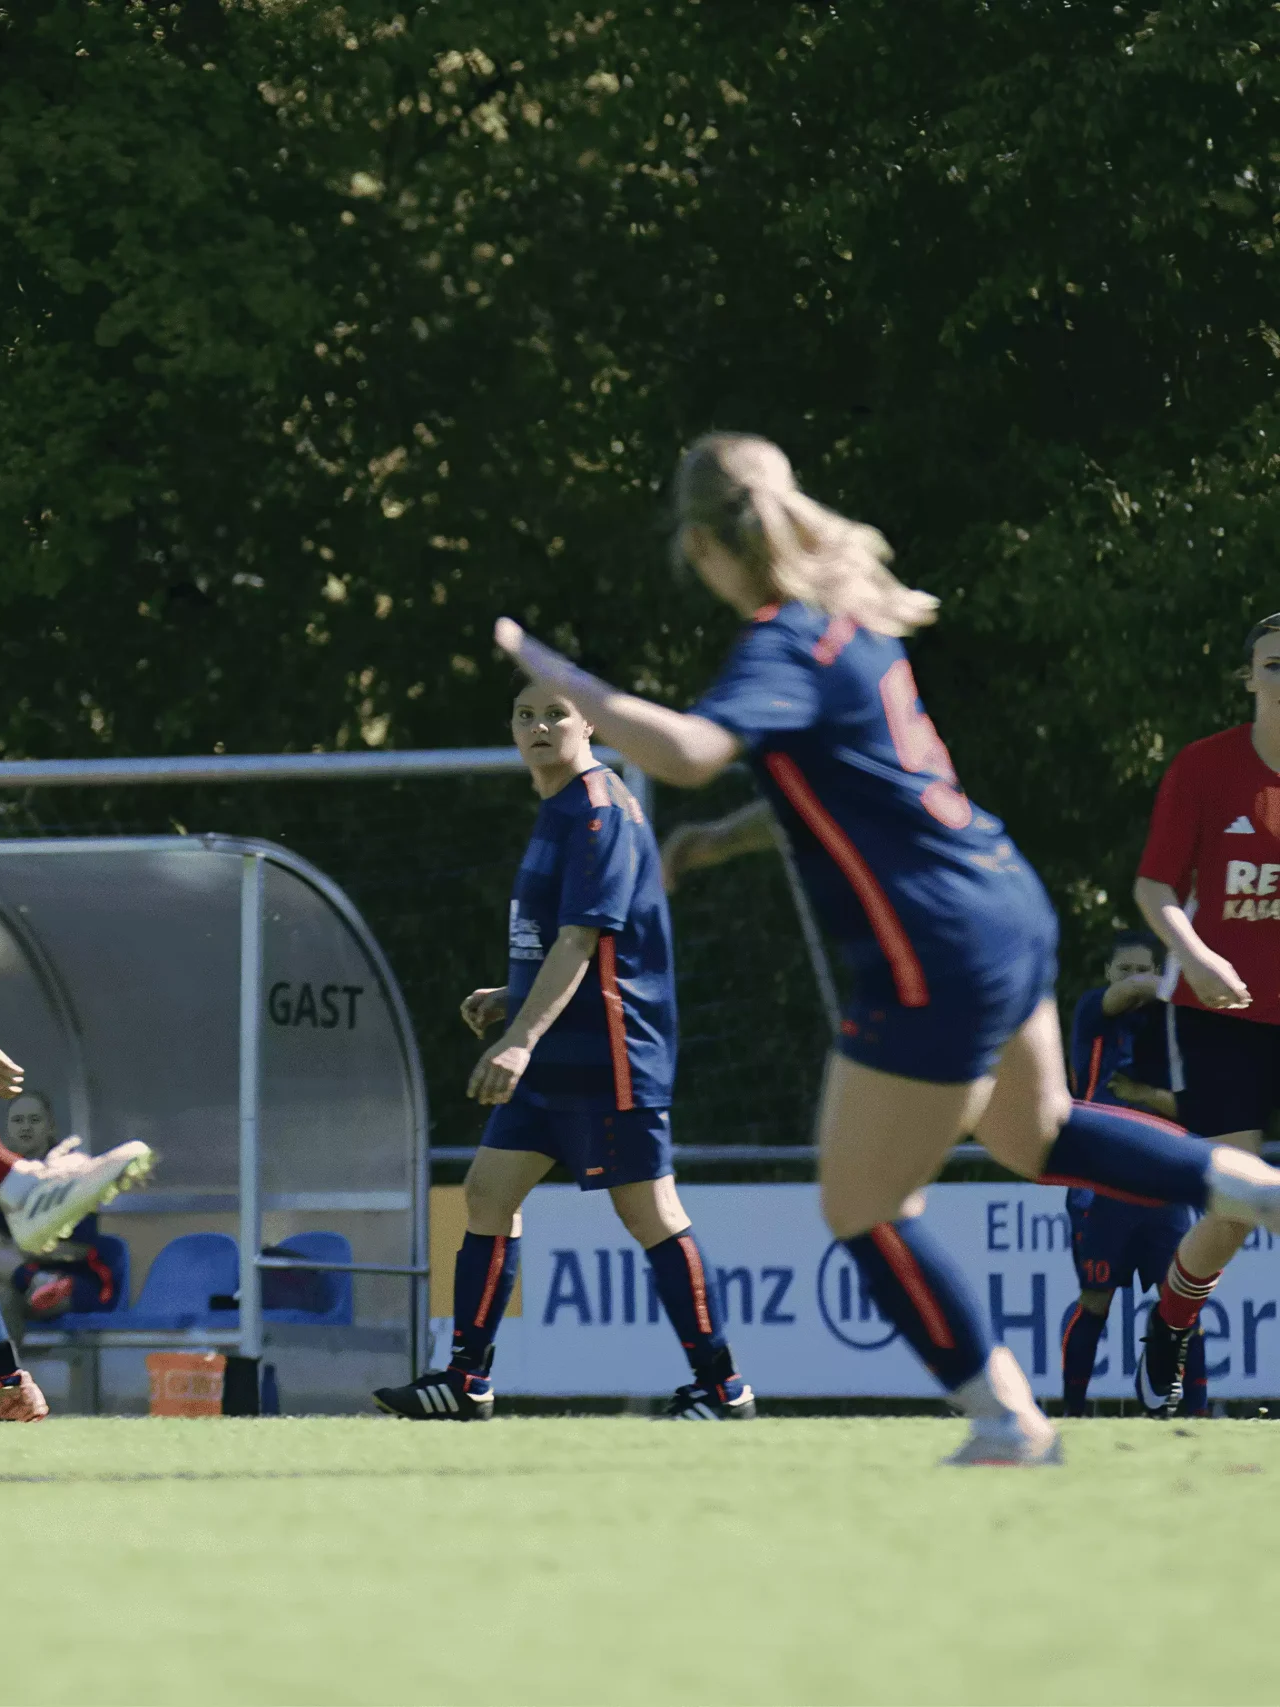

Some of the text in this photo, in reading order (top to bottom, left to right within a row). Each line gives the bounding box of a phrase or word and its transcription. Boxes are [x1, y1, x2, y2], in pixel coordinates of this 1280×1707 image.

[269, 982, 363, 1029] GAST
[542, 1248, 796, 1327] Allinz
[1083, 1259, 1110, 1282] 10
